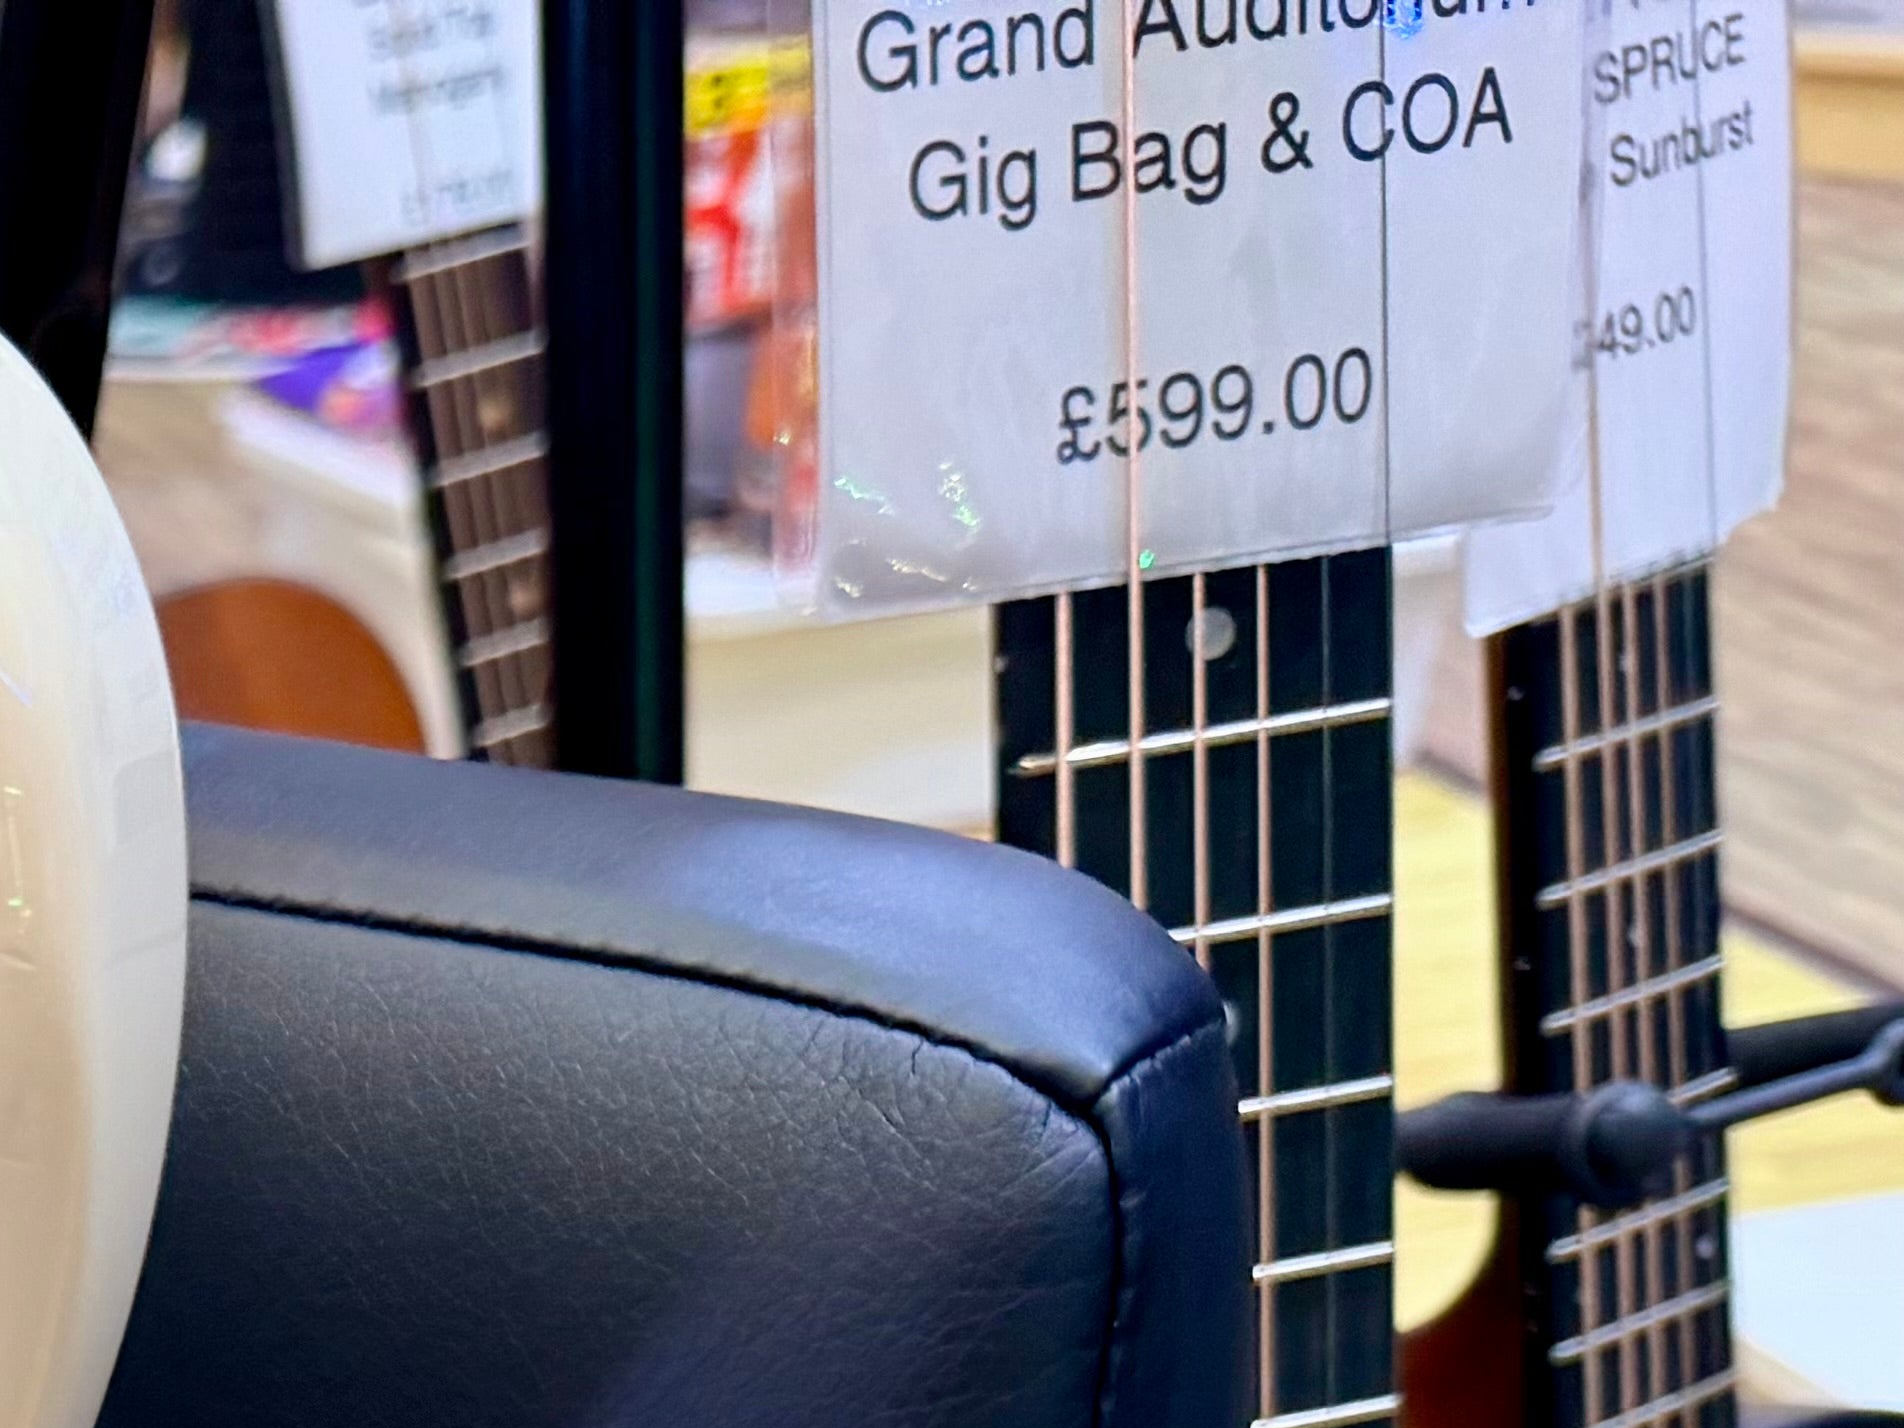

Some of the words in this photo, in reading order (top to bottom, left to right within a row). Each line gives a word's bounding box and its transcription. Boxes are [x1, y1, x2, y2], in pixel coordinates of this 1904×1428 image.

[856, 2, 1095, 93] Grand
[1594, 13, 1746, 104] SPRUCE
[908, 138, 1038, 231] Gig
[1071, 119, 1227, 205] Bag
[1260, 91, 1314, 175] &
[1342, 66, 1514, 163] COA
[1609, 100, 1755, 187] Sunburst
[1056, 346, 1373, 466] £599.00
